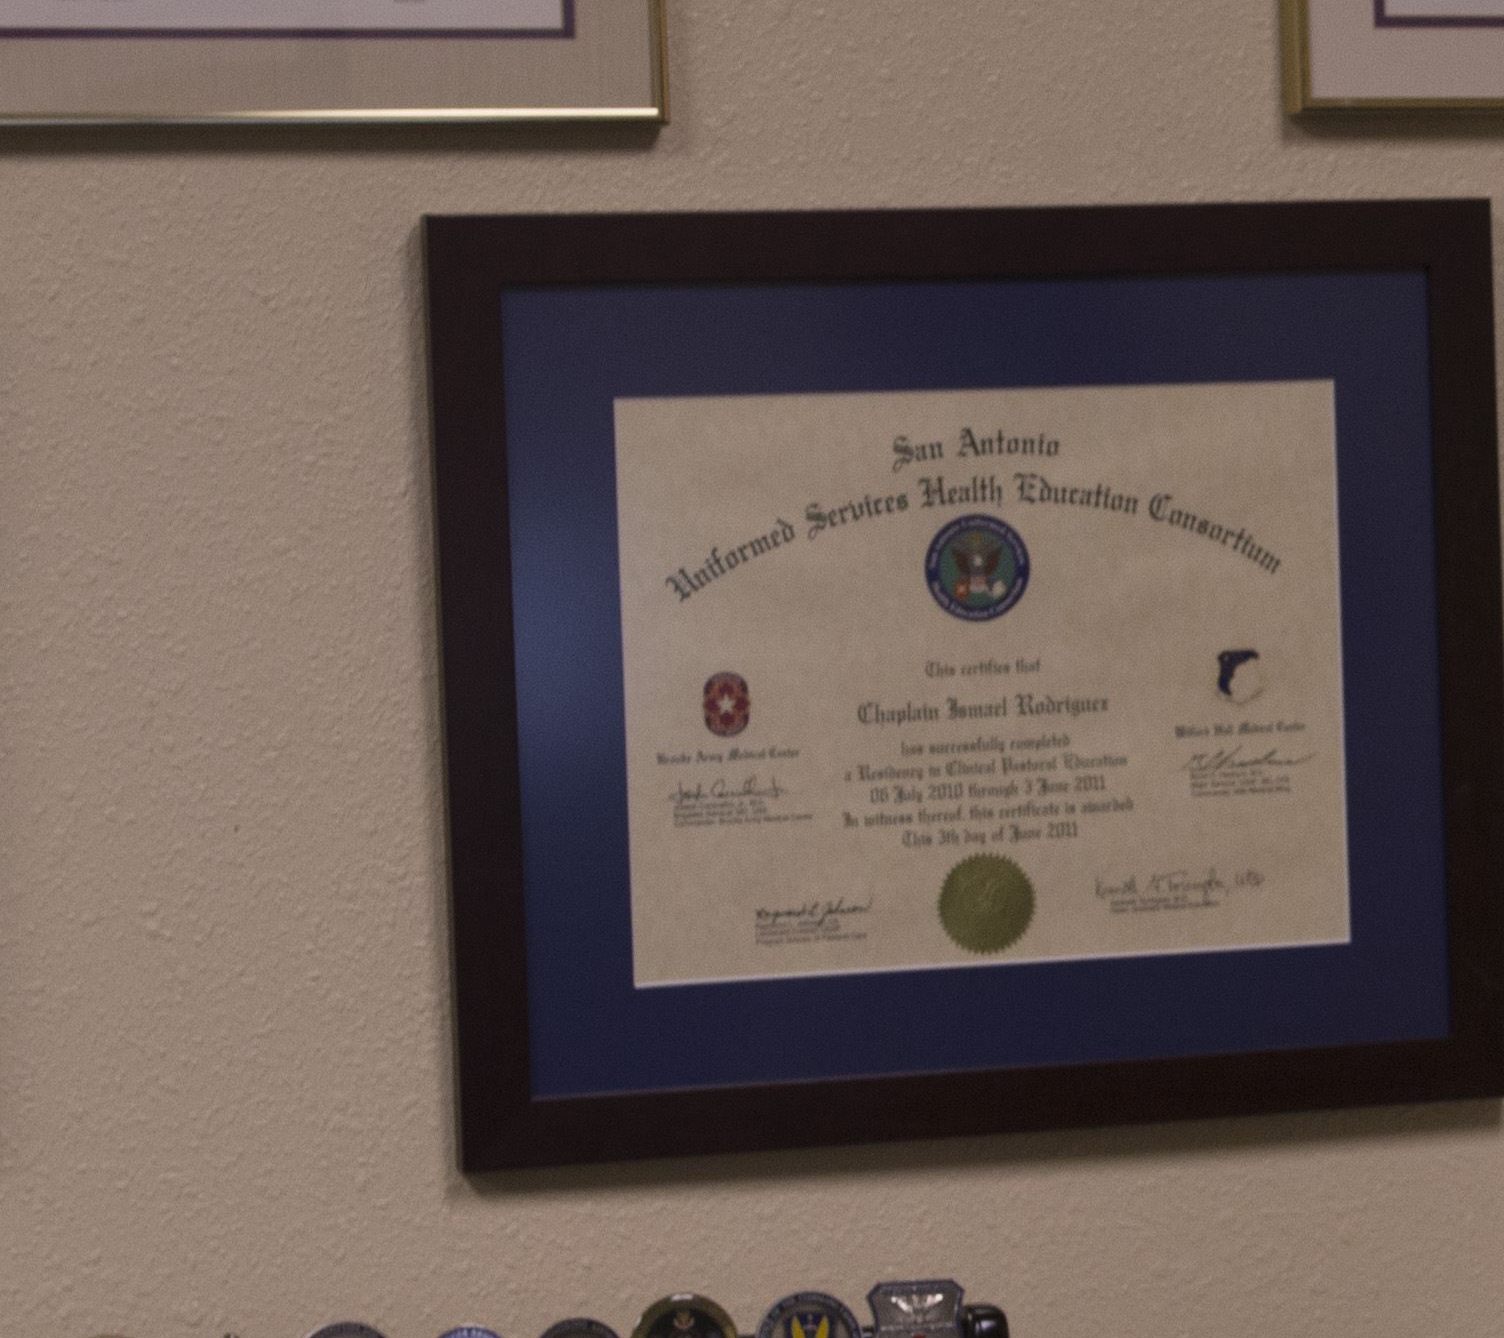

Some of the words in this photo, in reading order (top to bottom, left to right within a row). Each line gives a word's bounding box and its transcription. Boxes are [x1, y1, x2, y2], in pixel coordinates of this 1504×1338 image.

[892, 435, 944, 473] San
[957, 428, 1060, 458] Antonio
[665, 518, 796, 603] Uniformed
[805, 494, 909, 541] Services
[918, 475, 1003, 509] Health
[1013, 472, 1139, 516] Education
[1148, 493, 1282, 574] Consortium
[857, 700, 939, 726] Chaplain
[945, 696, 1007, 721] Ismael
[1015, 693, 1109, 718] Rodriguez
